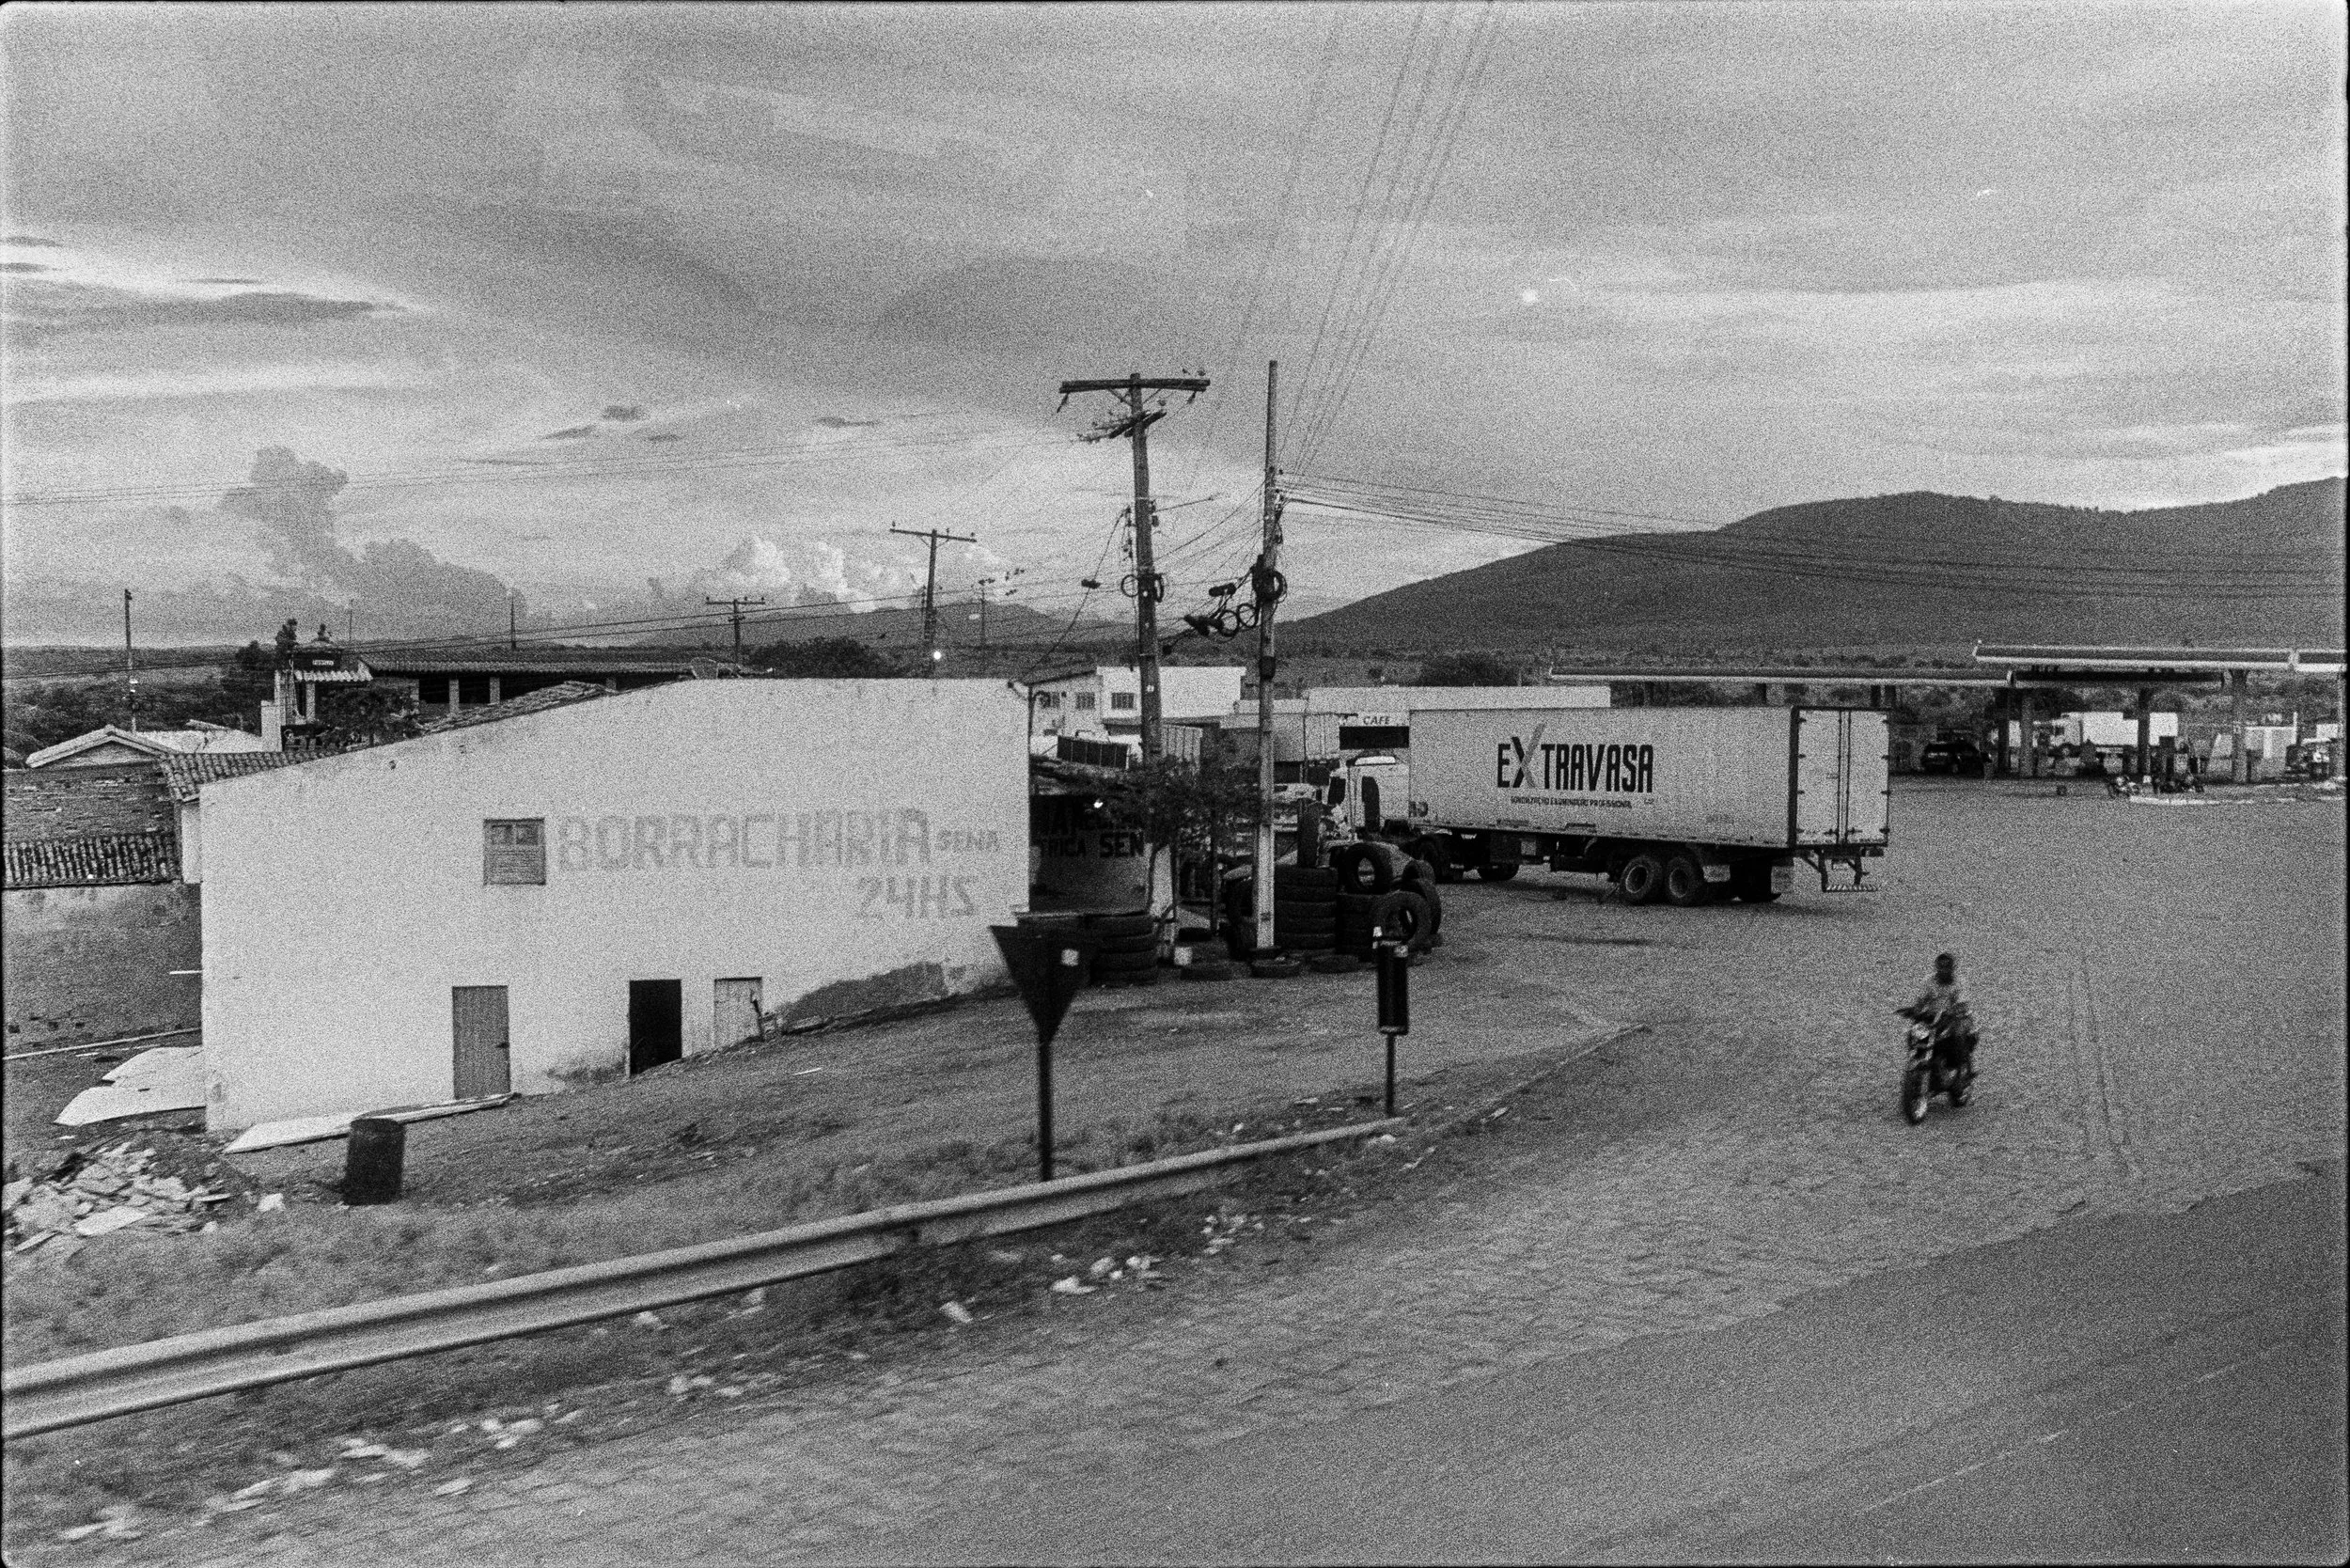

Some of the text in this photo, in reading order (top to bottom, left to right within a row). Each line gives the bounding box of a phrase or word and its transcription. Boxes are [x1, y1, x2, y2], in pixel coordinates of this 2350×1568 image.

[1362, 715, 1390, 726] CAFE
[1496, 721, 1654, 793] EXTRAVASA
[558, 808, 1001, 871] BORRACHARIA SENA
[855, 875, 979, 919] 24HS
